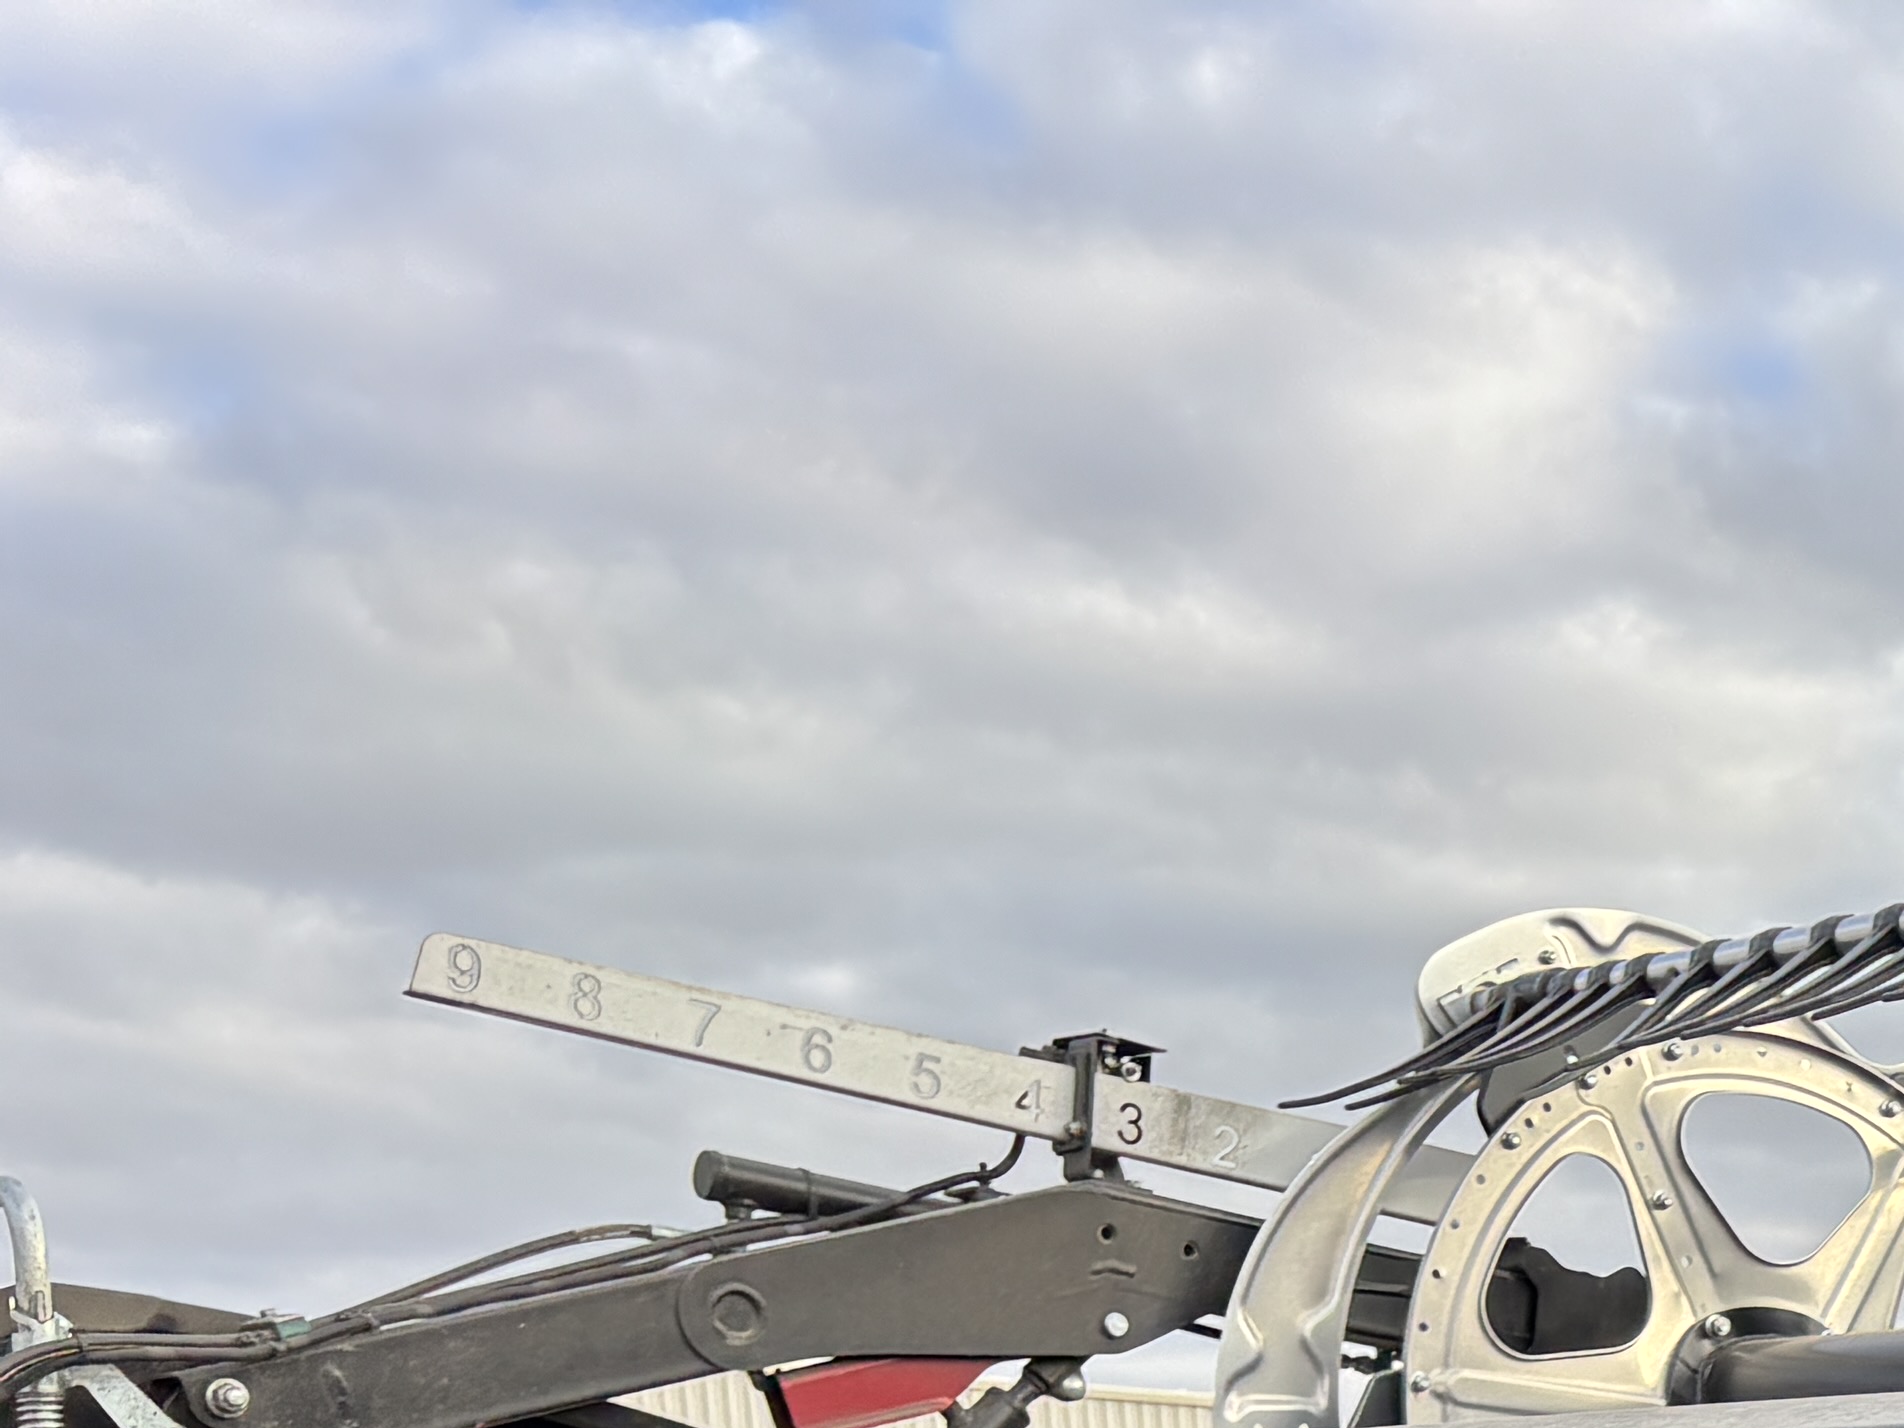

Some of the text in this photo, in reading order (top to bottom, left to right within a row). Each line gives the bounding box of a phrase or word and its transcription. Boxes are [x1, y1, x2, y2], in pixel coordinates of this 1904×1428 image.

[448, 943, 1243, 1170] 9 8 7 6 5 4 3 2
